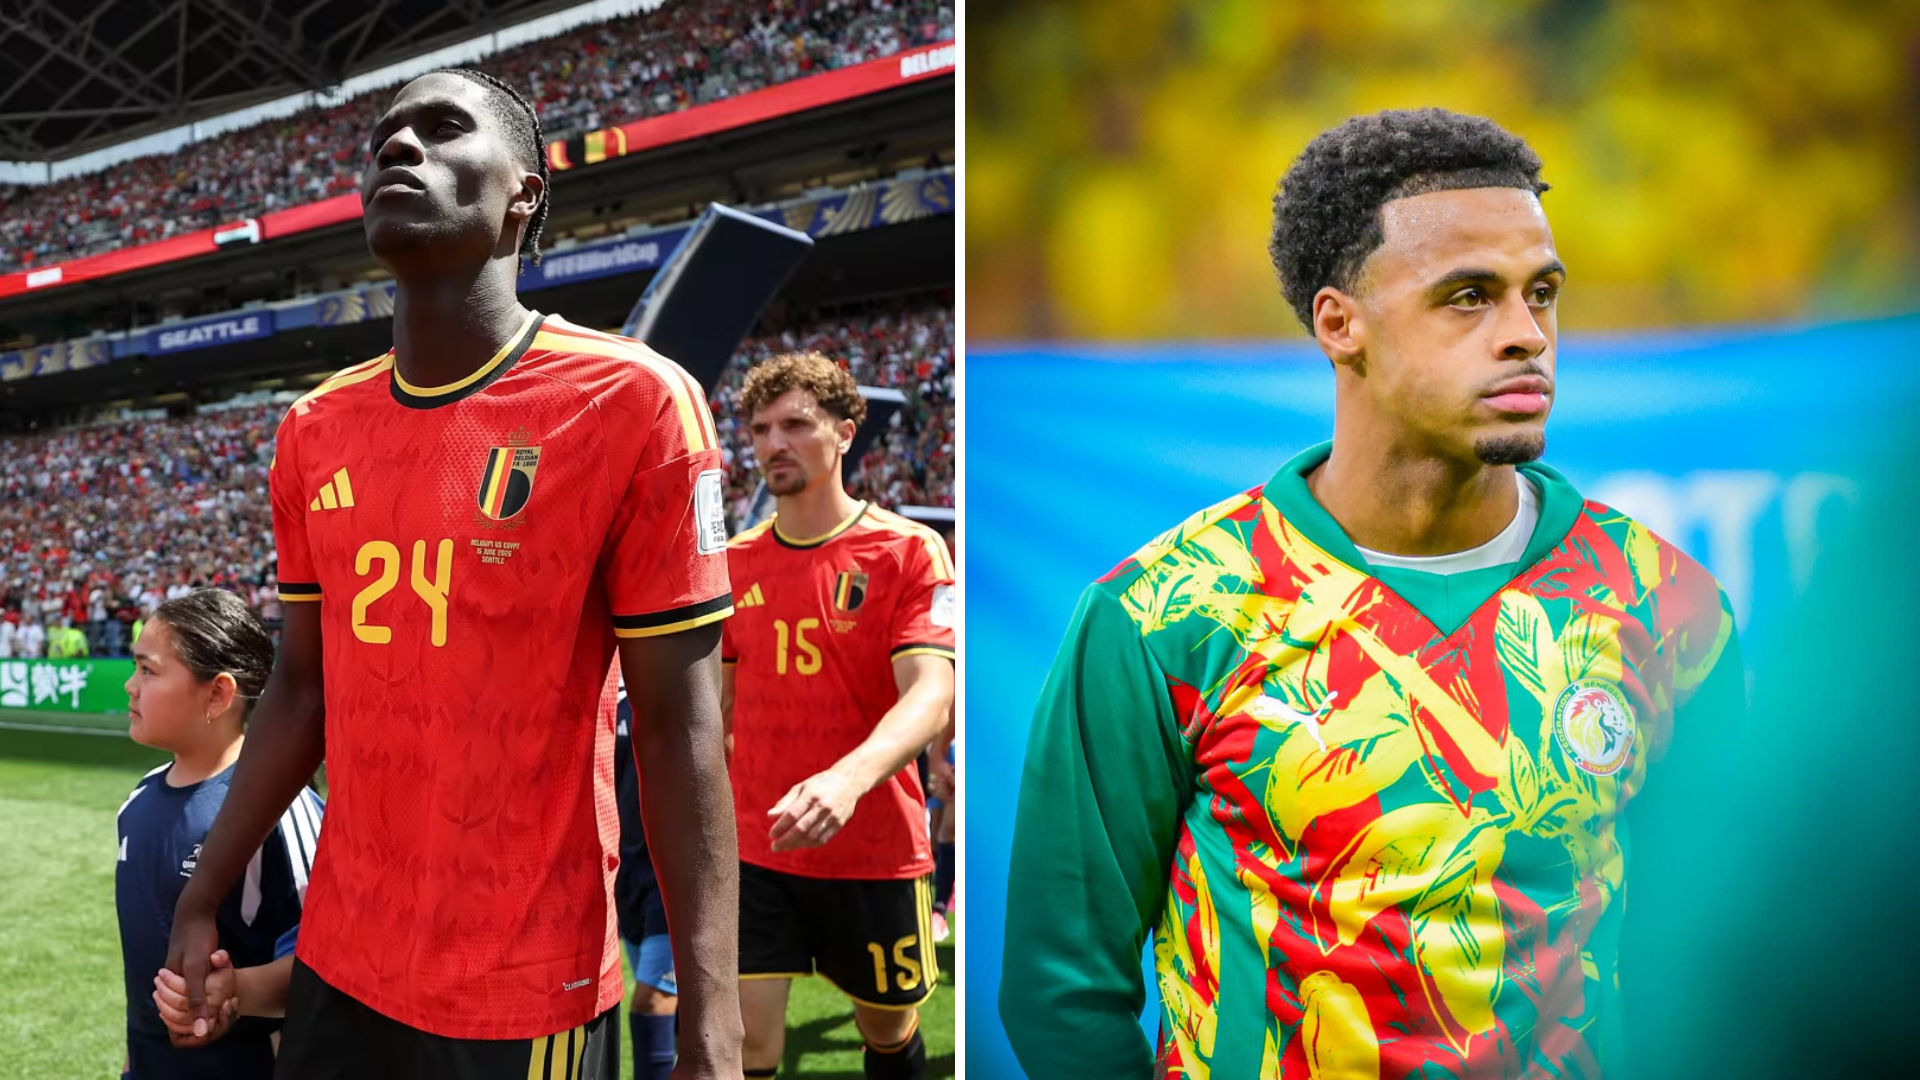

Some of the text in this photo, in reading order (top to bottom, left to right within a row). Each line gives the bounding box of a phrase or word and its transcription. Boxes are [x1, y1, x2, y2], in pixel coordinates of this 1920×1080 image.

[543, 242, 659, 279] #FIFAWorldCup
[159, 317, 260, 350] SEATTLE
[352, 538, 454, 647] 24
[773, 617, 823, 675] 15
[867, 933, 921, 994] 15
